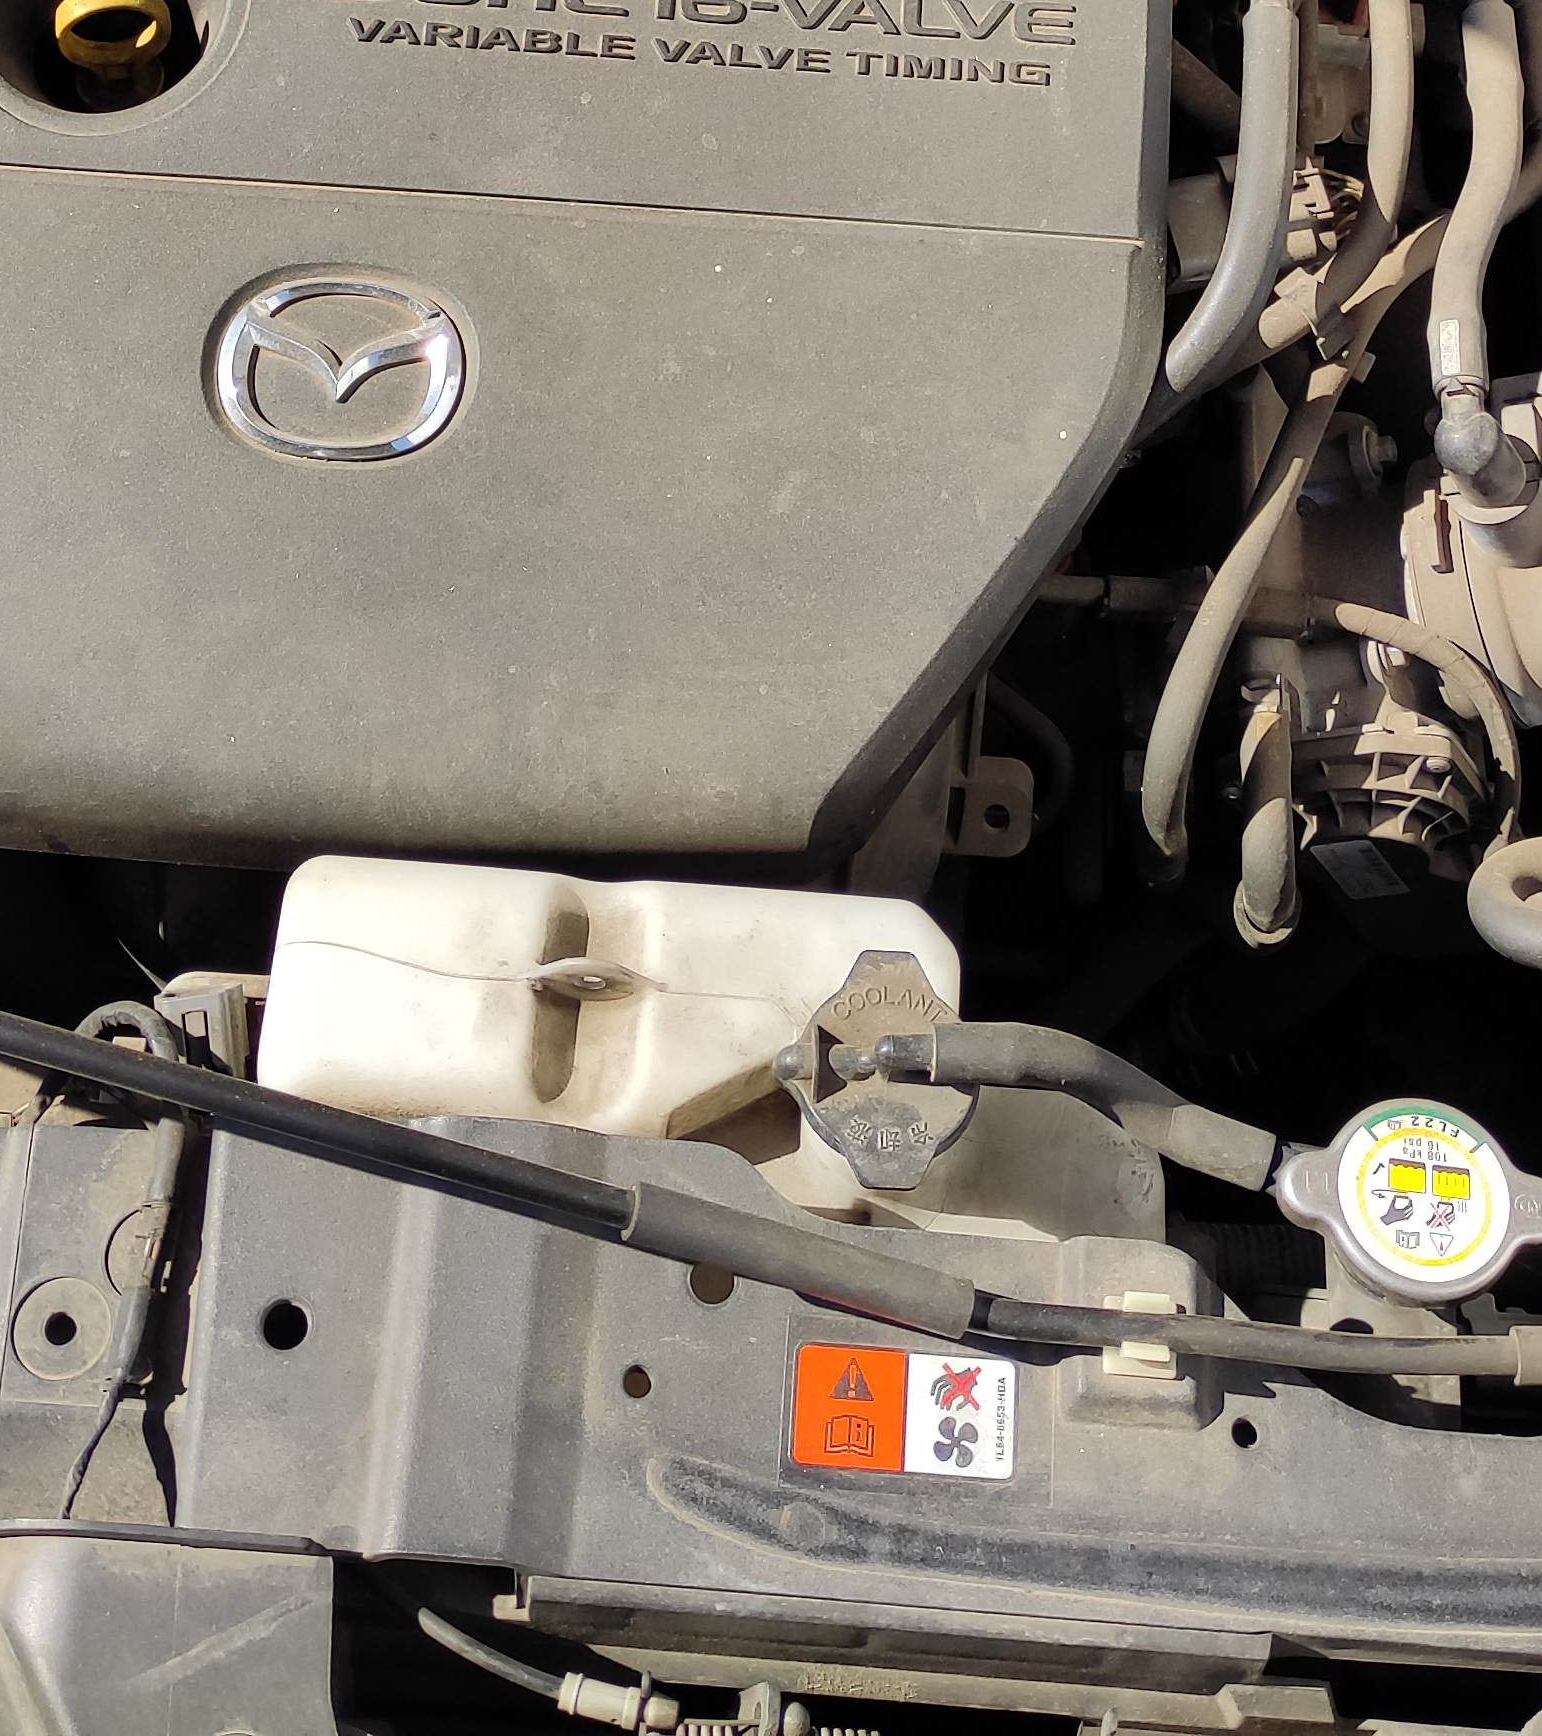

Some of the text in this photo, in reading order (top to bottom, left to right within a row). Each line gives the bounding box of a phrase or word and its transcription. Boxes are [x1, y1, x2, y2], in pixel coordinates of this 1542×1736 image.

[347, 16, 1053, 87] VARIABLE VALVE TIMING
[832, 984, 949, 1023] COOLANT
[1410, 1115, 1460, 1139] FL22
[1427, 1149, 1448, 1163] 108
